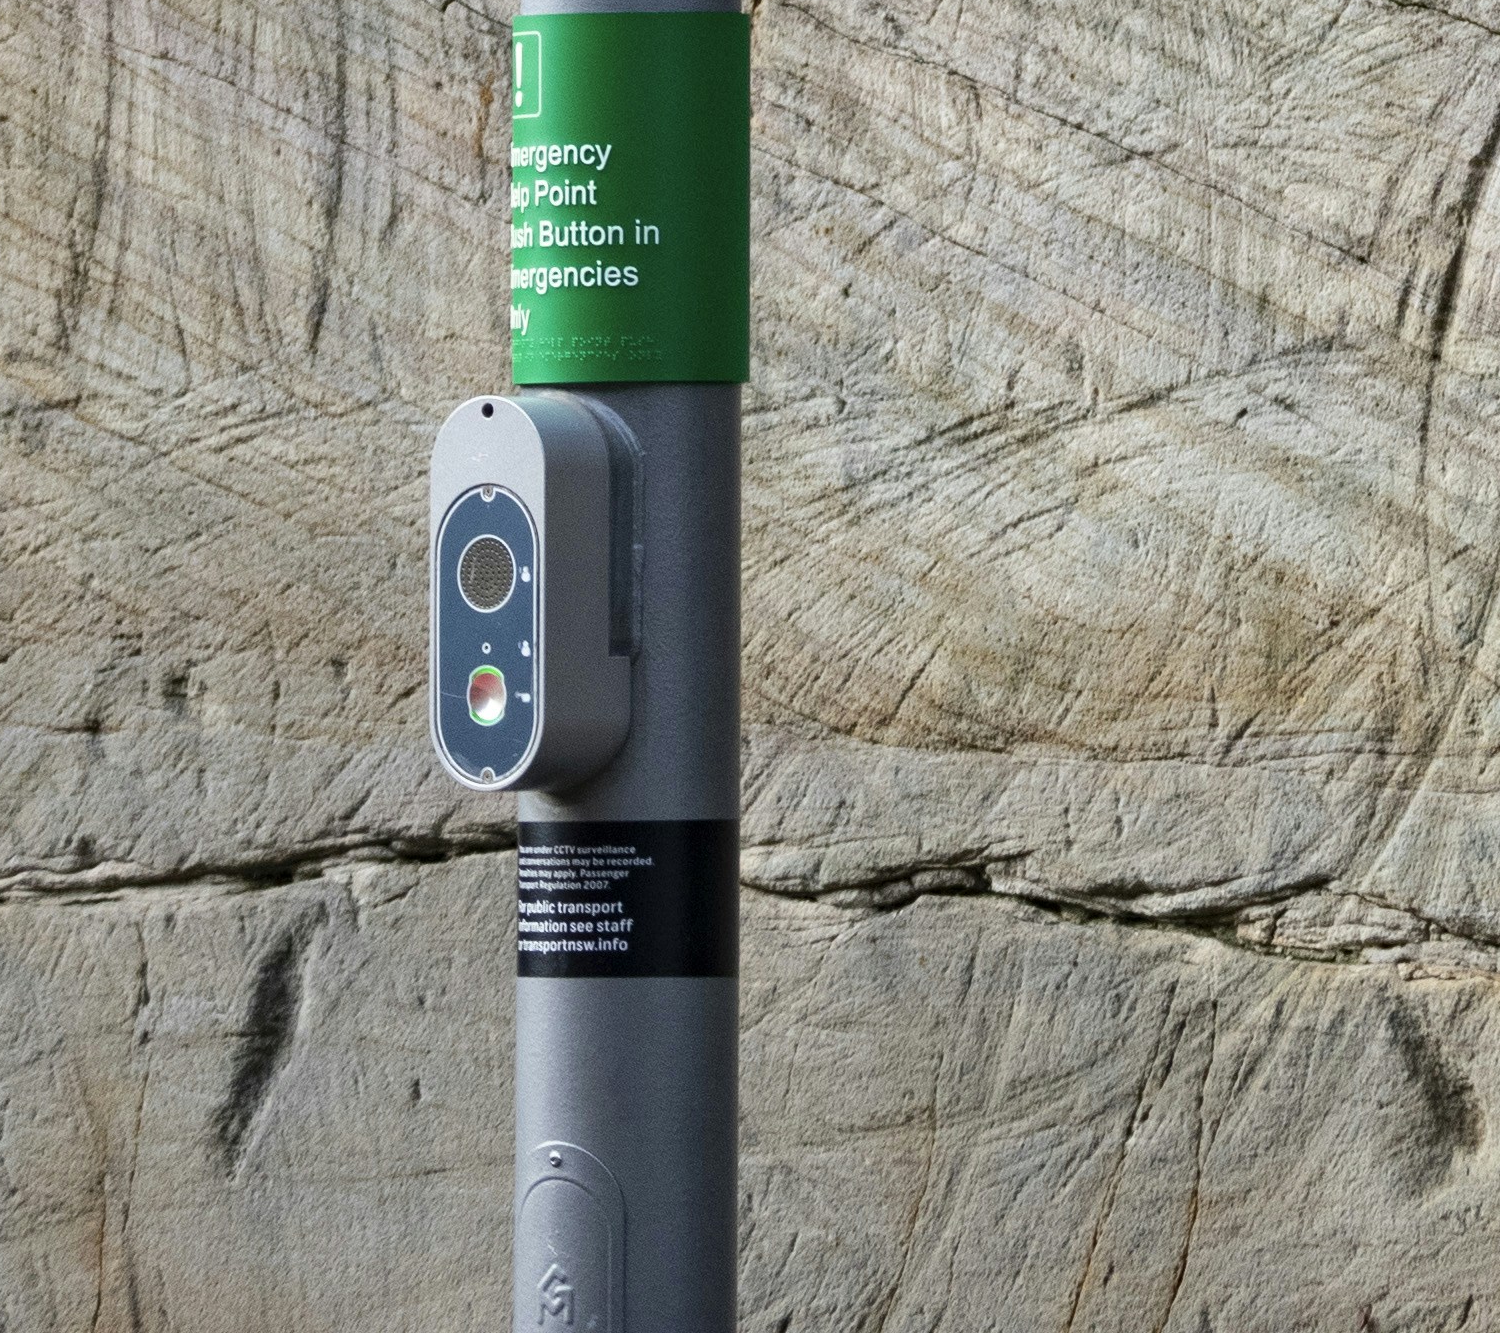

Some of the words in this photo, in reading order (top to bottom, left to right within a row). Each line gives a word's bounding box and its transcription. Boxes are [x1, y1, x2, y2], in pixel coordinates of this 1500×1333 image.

[510, 141, 612, 173] mergency
[510, 180, 530, 214] elp
[534, 179, 597, 207] Point
[510, 221, 533, 249] ush
[539, 219, 624, 247] Button
[635, 218, 660, 245] in
[510, 259, 639, 295] mergencies
[553, 845, 576, 854] CCTV
[577, 845, 636, 854] surveillance
[571, 858, 590, 867] may
[592, 856, 605, 866] be
[606, 856, 655, 867] recorded.
[580, 868, 629, 880] Passenger
[527, 899, 556, 916] public
[557, 901, 623, 916] transport
[569, 921, 594, 933] see
[596, 918, 634, 933] staff
